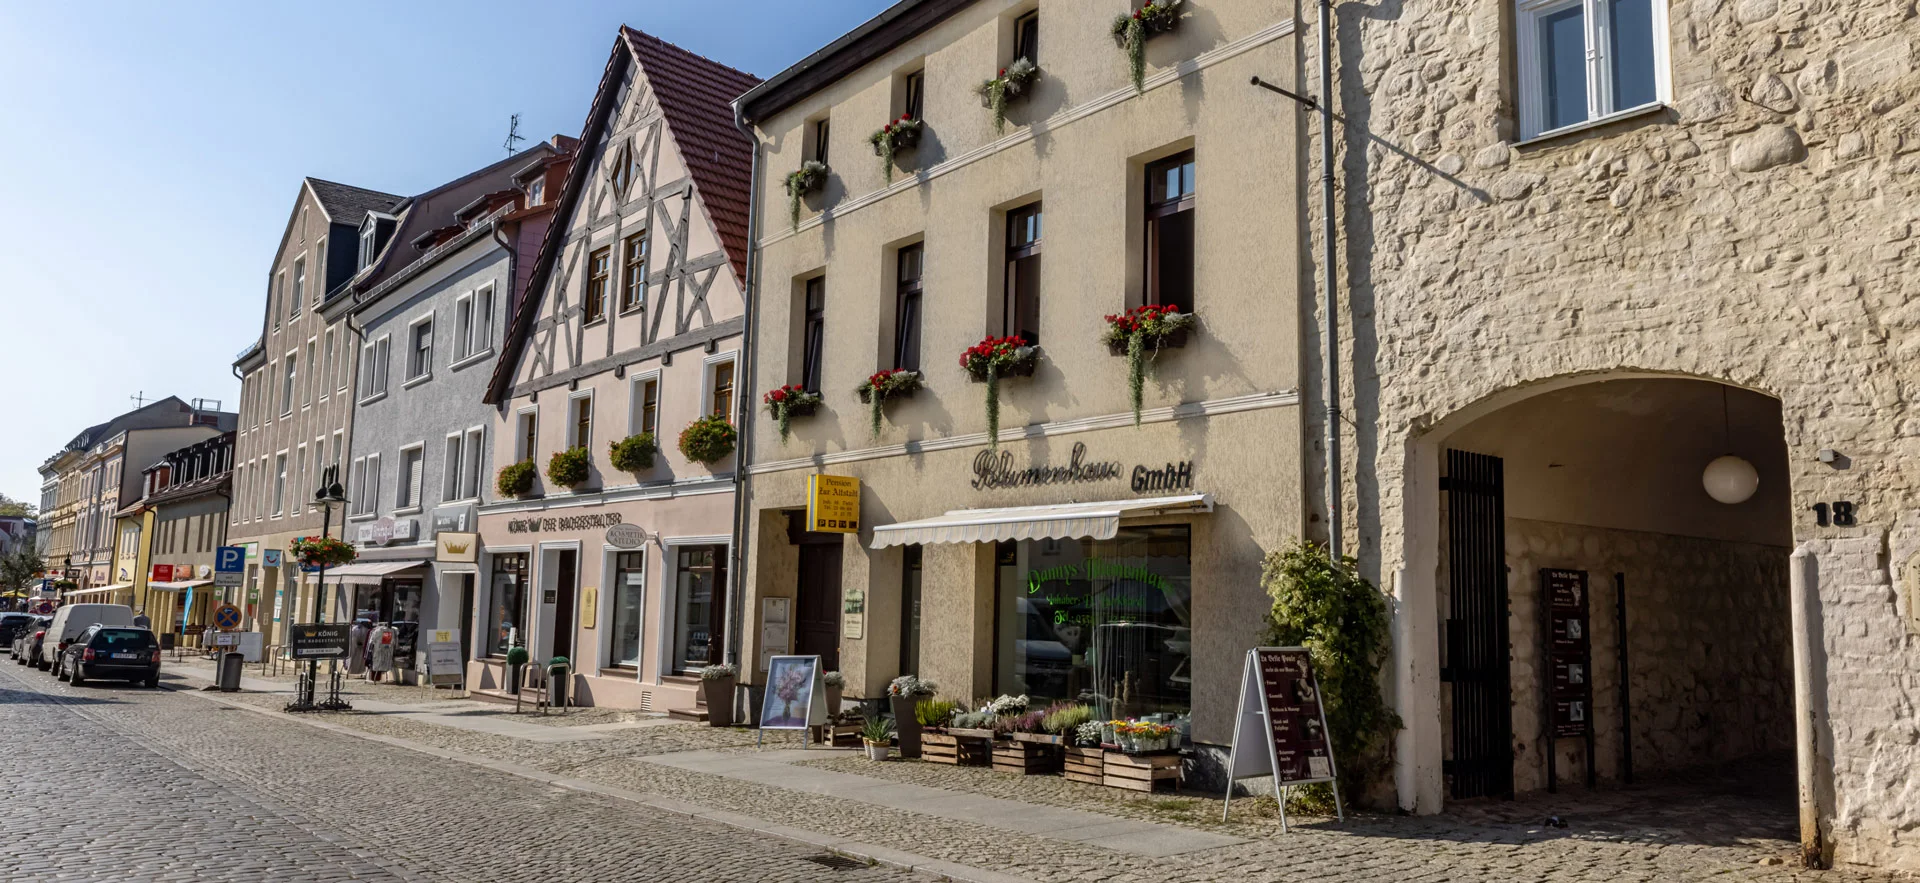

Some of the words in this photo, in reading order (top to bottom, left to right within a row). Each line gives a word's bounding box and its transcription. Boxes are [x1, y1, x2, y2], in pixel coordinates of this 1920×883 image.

[970, 441, 1119, 489] Blumenhaus
[1130, 460, 1192, 492] GmbH
[826, 478, 852, 487] Pension
[832, 488, 858, 497] Altstadt
[1812, 501, 1853, 527] 18
[610, 530, 644, 539] KOSMETIK
[614, 537, 641, 545] STUDIO
[222, 550, 239, 569] P
[1028, 563, 1079, 595] Dannys
